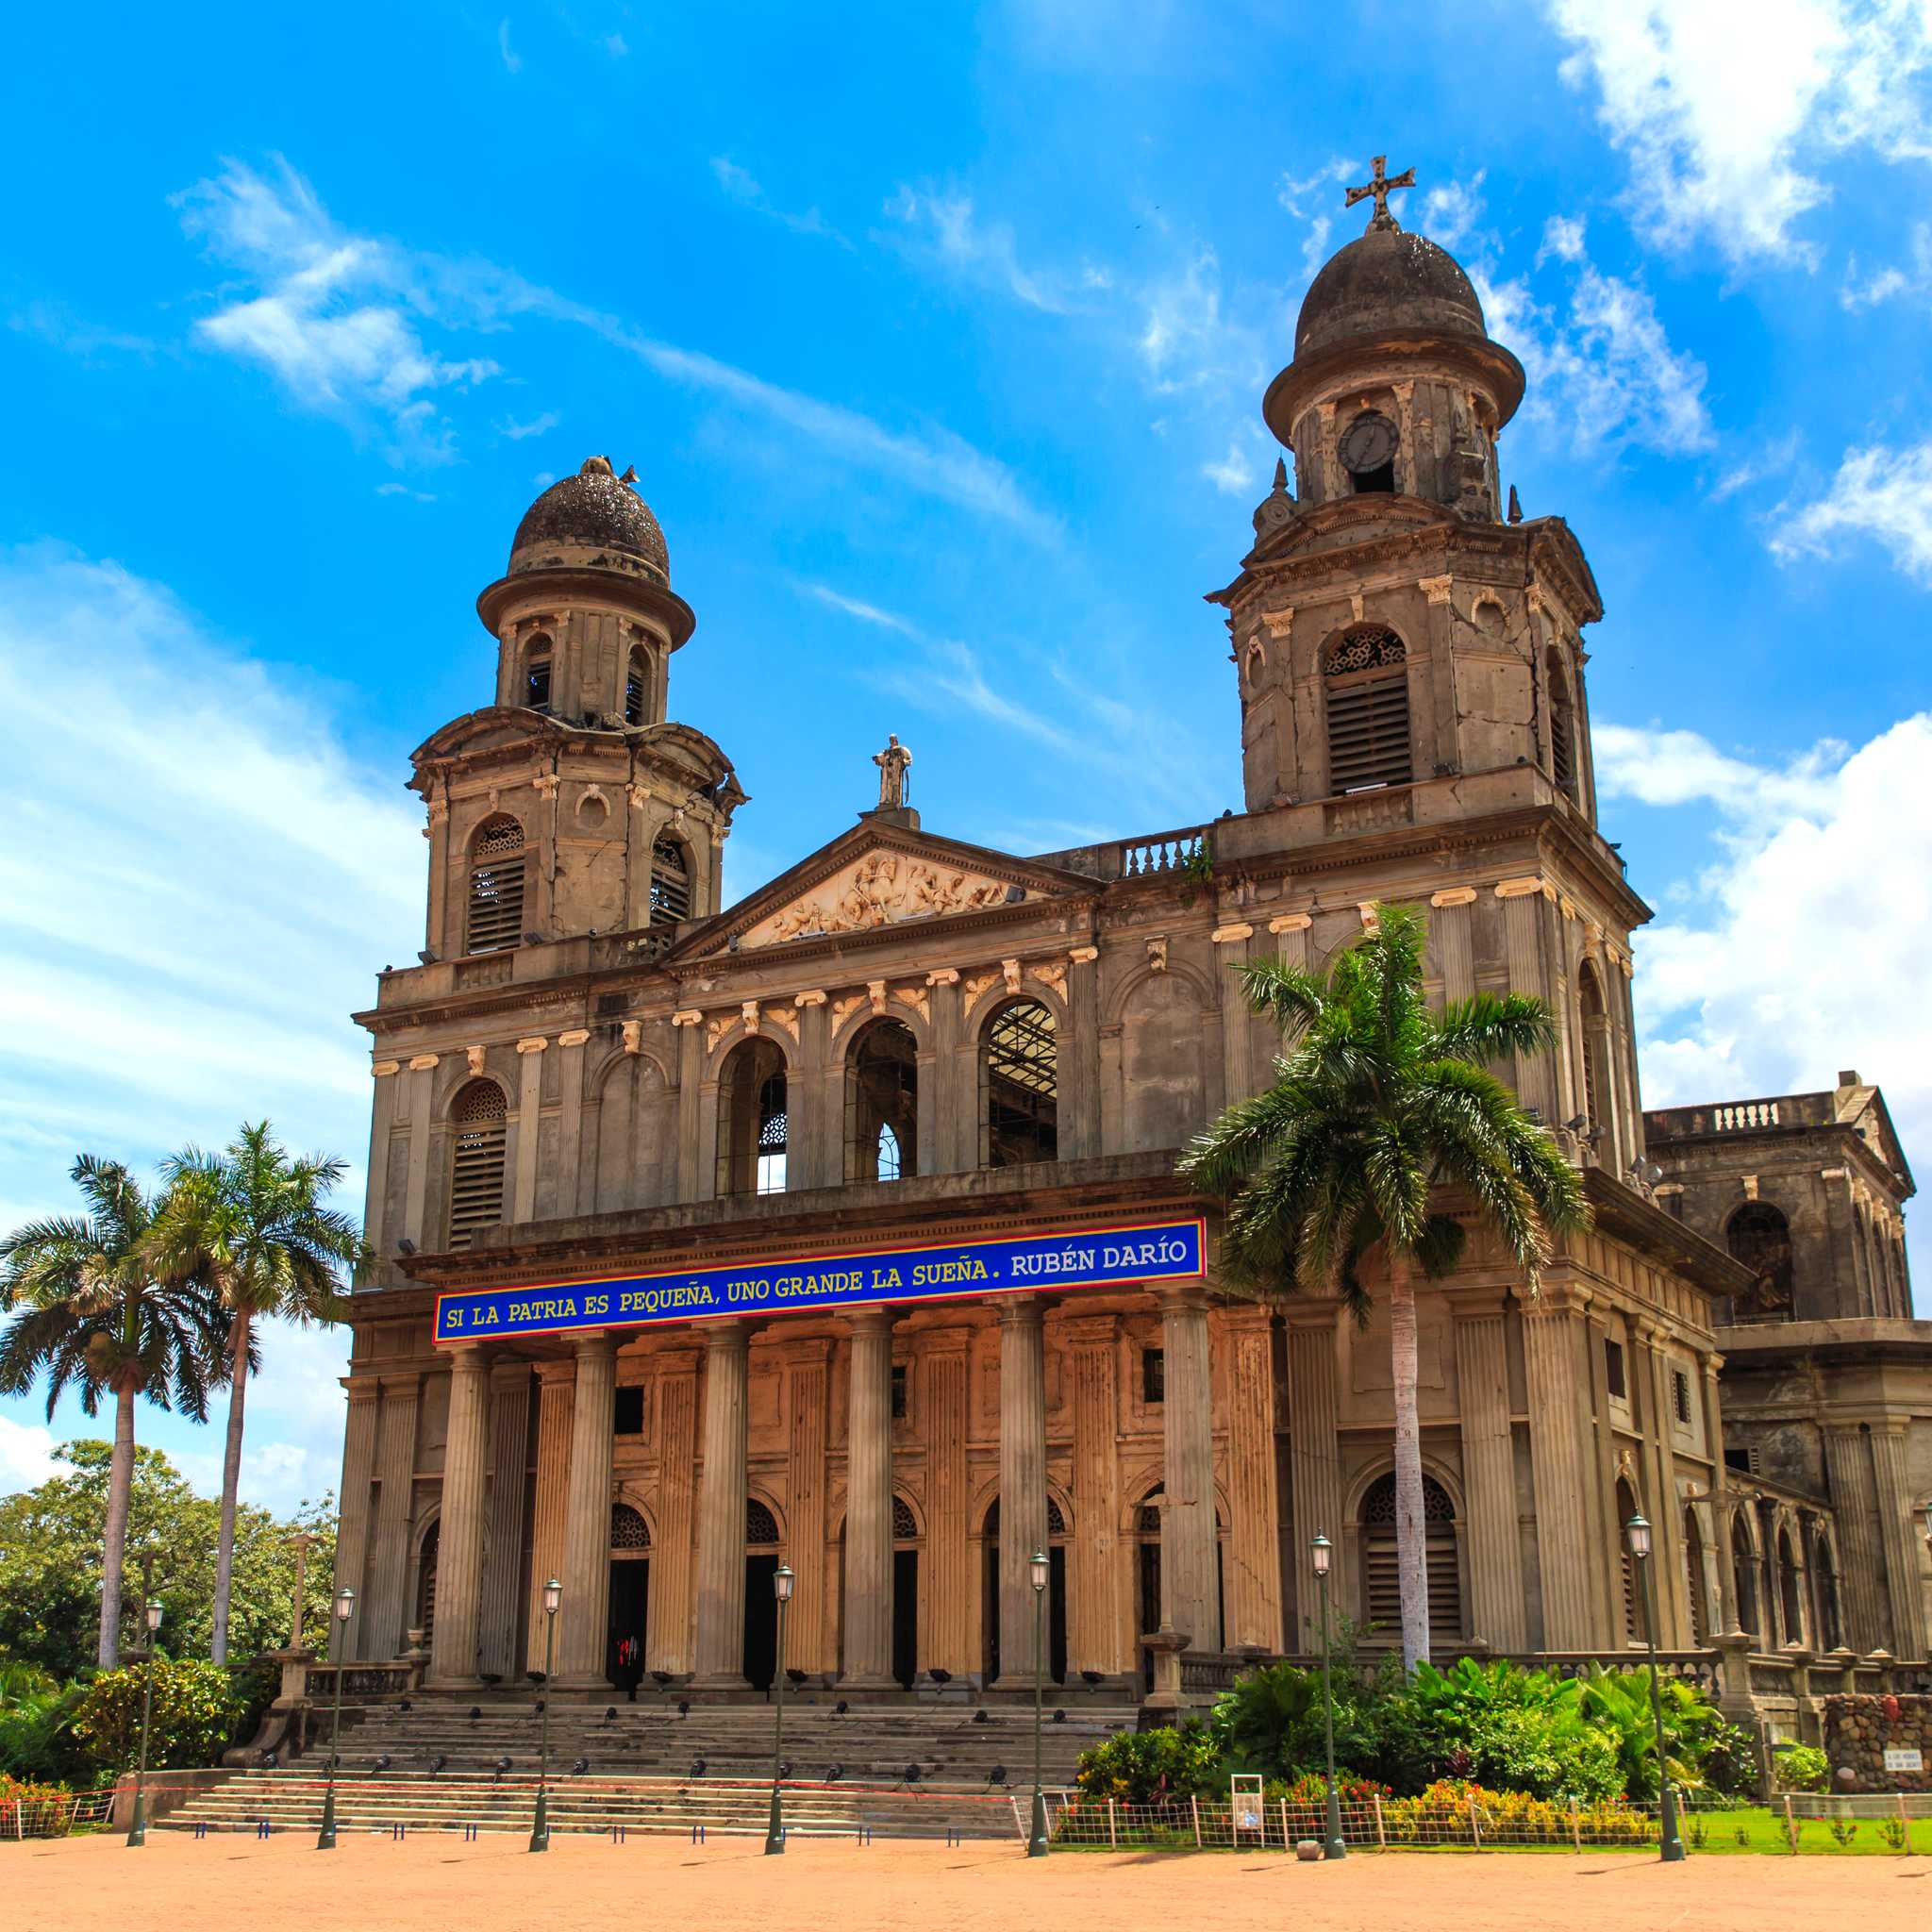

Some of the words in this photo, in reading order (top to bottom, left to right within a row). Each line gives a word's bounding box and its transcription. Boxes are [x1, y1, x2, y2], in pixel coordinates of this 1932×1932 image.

[445, 1308, 464, 1327] SI
[471, 1306, 500, 1326] LA
[507, 1298, 577, 1323] PATRIA
[583, 1294, 609, 1315] ES
[618, 1280, 721, 1313] PEQUEÑA,
[726, 1277, 771, 1302] UNO
[774, 1271, 863, 1298] GRANDE
[871, 1268, 903, 1290] LA
[912, 1255, 1000, 1286] SUEÑA.
[1010, 1243, 1095, 1276] RUBÉN
[1102, 1235, 1187, 1269] DARÍO
